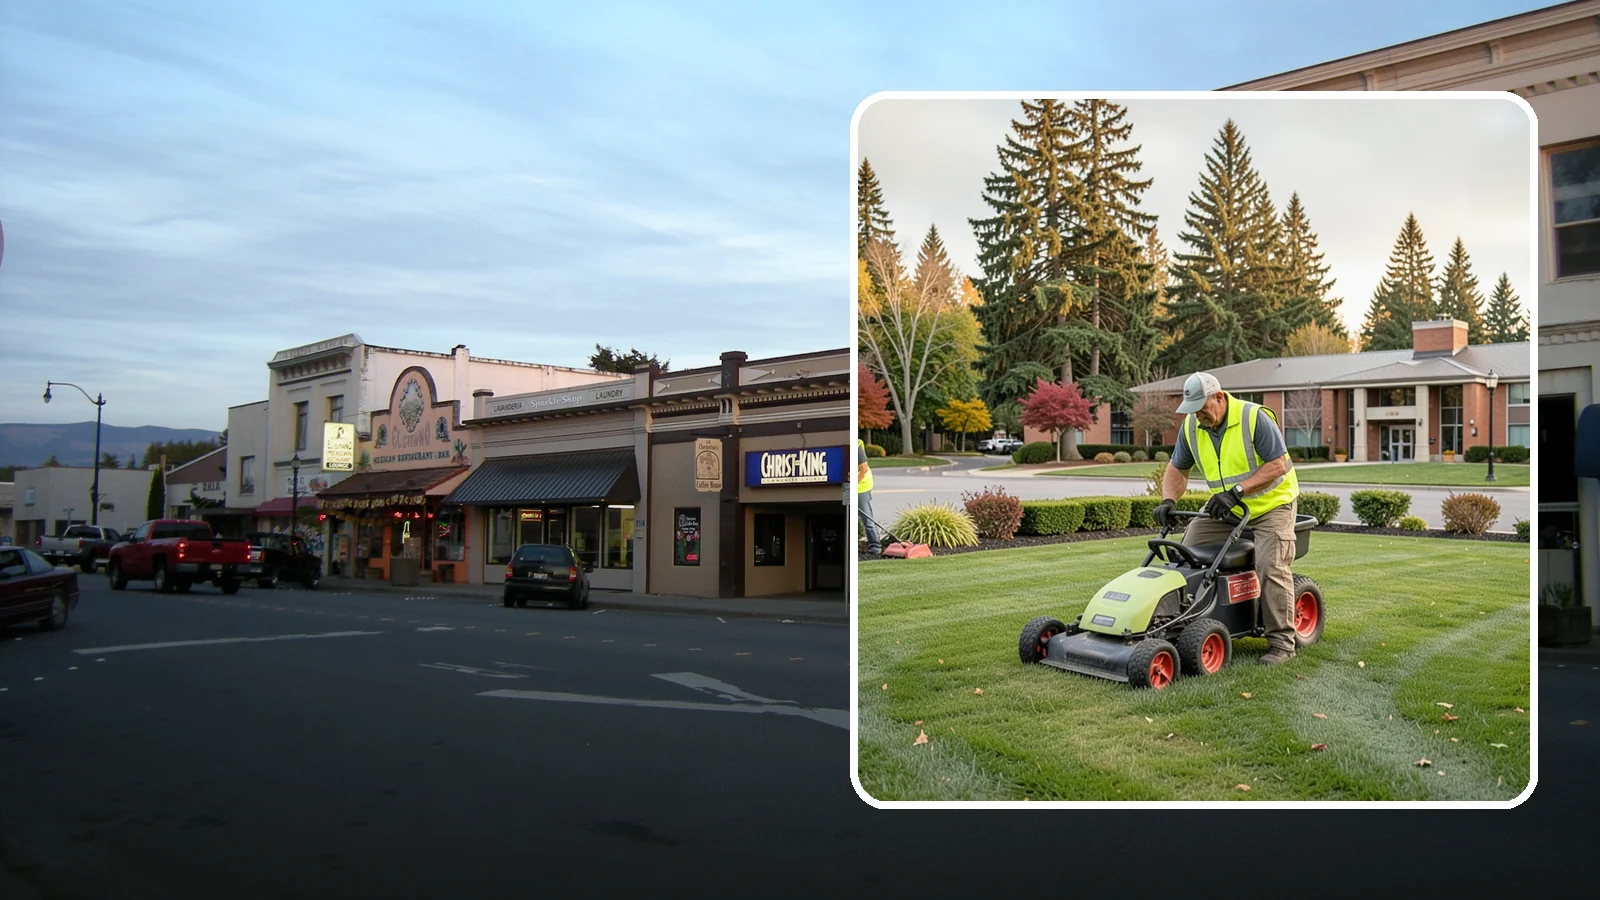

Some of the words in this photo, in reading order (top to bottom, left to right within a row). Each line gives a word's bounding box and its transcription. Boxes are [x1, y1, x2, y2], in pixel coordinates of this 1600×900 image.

[595, 389, 623, 400] LAUNDRY
[494, 402, 523, 413] LAVANDERIA
[531, 396, 561, 409] Sparkle
[561, 394, 582, 405] Shop
[374, 456, 396, 464] MEXICAN
[397, 451, 433, 462] RESTAURANT
[437, 450, 450, 459] BAR
[761, 452, 797, 478] CHRIST
[799, 450, 827, 476] KING
[696, 481, 709, 489] Coffee
[710, 481, 722, 489] House
